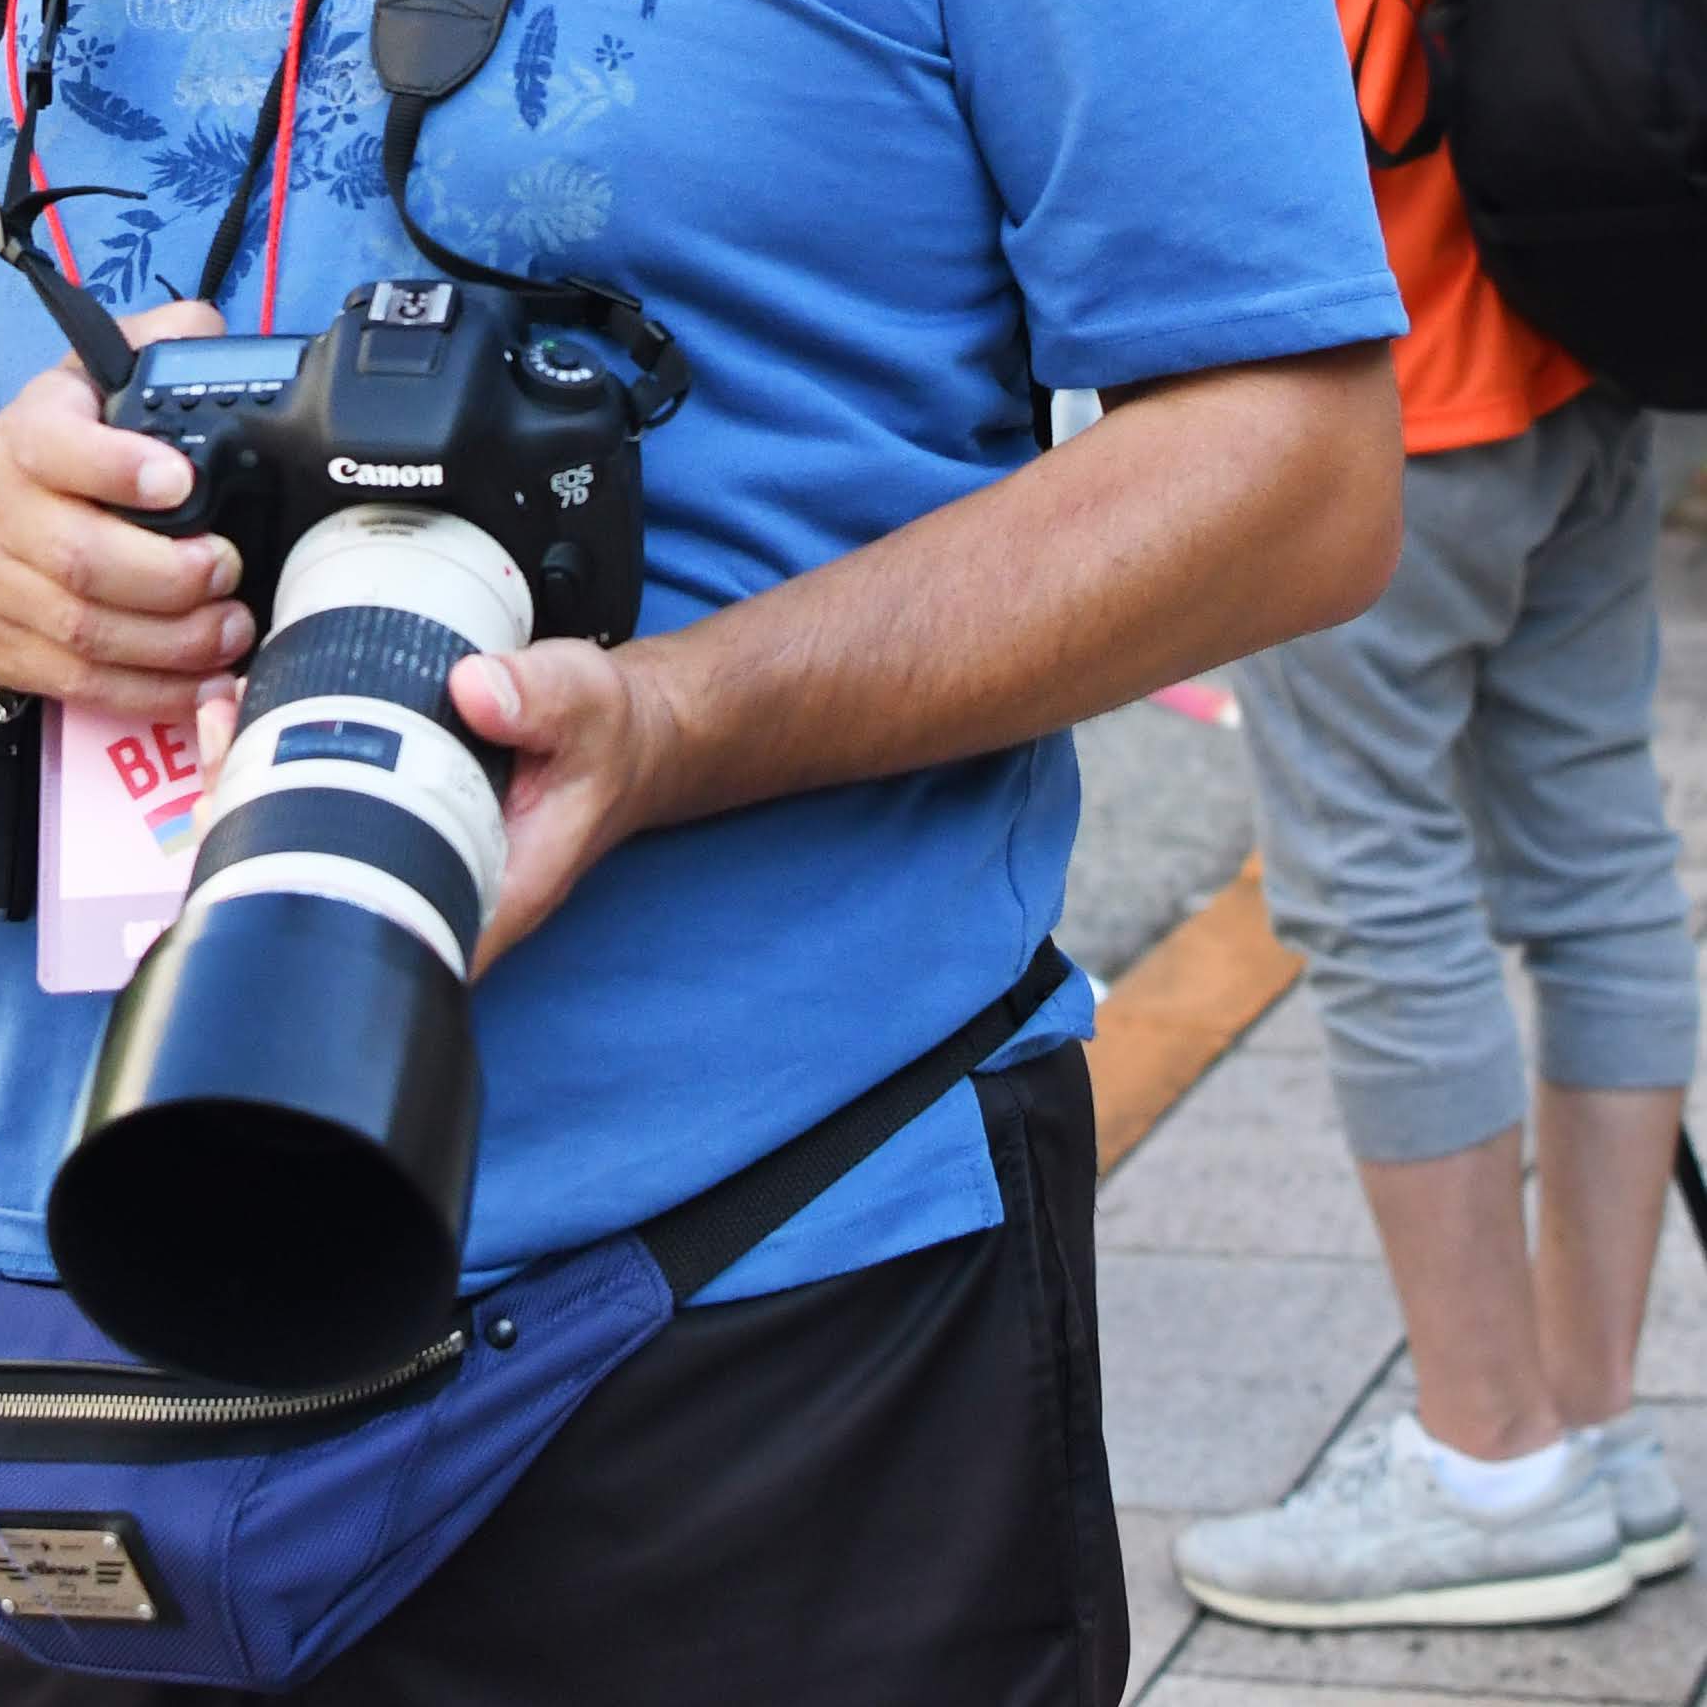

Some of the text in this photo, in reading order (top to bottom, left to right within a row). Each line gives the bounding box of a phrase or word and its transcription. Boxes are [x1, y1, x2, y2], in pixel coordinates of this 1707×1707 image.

[327, 456, 444, 488] Canon
[549, 462, 595, 494] EOS
[557, 485, 590, 509] 7D
[105, 723, 198, 800] BE
